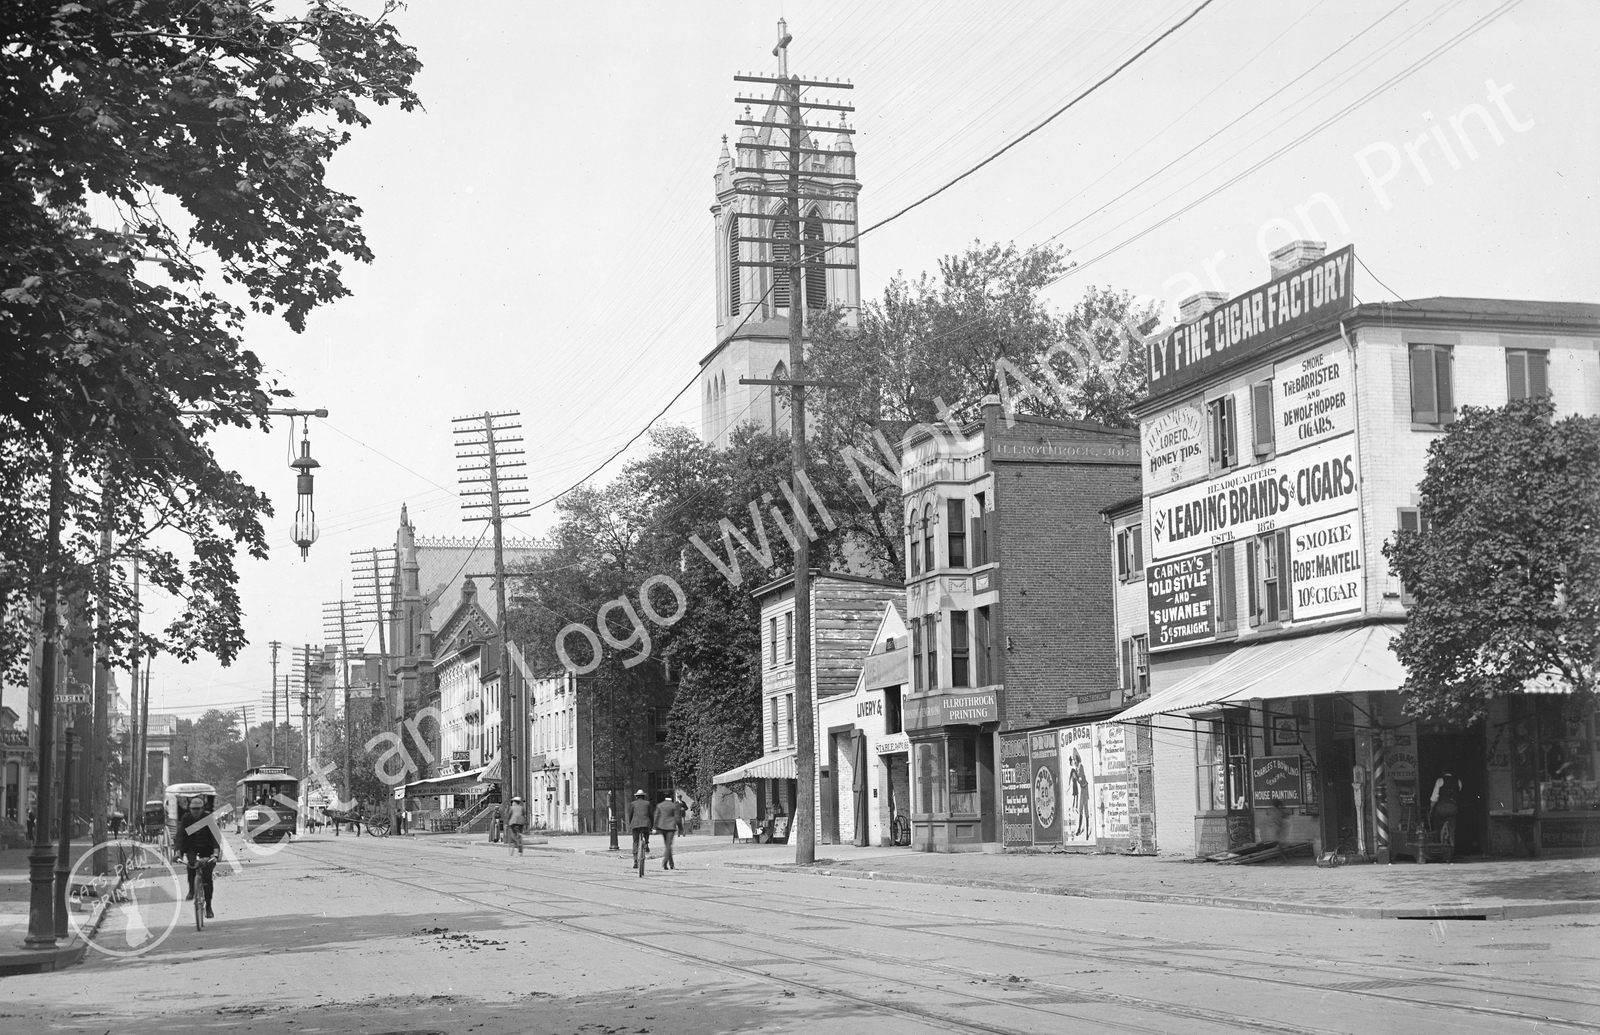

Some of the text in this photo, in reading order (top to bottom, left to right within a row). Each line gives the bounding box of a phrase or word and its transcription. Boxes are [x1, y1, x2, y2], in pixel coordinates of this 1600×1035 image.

[1149, 251, 1350, 382] LY FINE CIGAR FACTORY
[1302, 354, 1324, 373] SMOKE
[1295, 363, 1340, 392] BARRISTER
[1306, 389, 1321, 401] AND
[1313, 391, 1347, 415] HOPPER
[1298, 416, 1336, 440] CIGARS.
[1150, 449, 1179, 473] HONEY
[1207, 465, 1278, 495] HEADQUARTERS
[1153, 508, 1167, 543] ALL
[1167, 491, 1227, 543] LEADING
[1228, 473, 1290, 526] BRANDS
[1296, 453, 1358, 507] CIGARS.
[1256, 519, 1276, 533] 1876
[1295, 523, 1352, 553] SMOKE
[1154, 556, 1204, 580] CARNEY'S
[1313, 549, 1361, 578] MANTELL
[1174, 591, 1190, 604] AND
[1315, 581, 1358, 605] CIGAR
[856, 700, 877, 719] LIVERY
[949, 708, 988, 720] PRINTING
[1032, 734, 1056, 751] DRUM
[1060, 731, 1072, 748] SUB
[1072, 726, 1090, 741] ROSA
[1254, 761, 1273, 778] CHARLES
[1265, 772, 1287, 786] GENERAL
[1254, 790, 1271, 800] HOUSE
